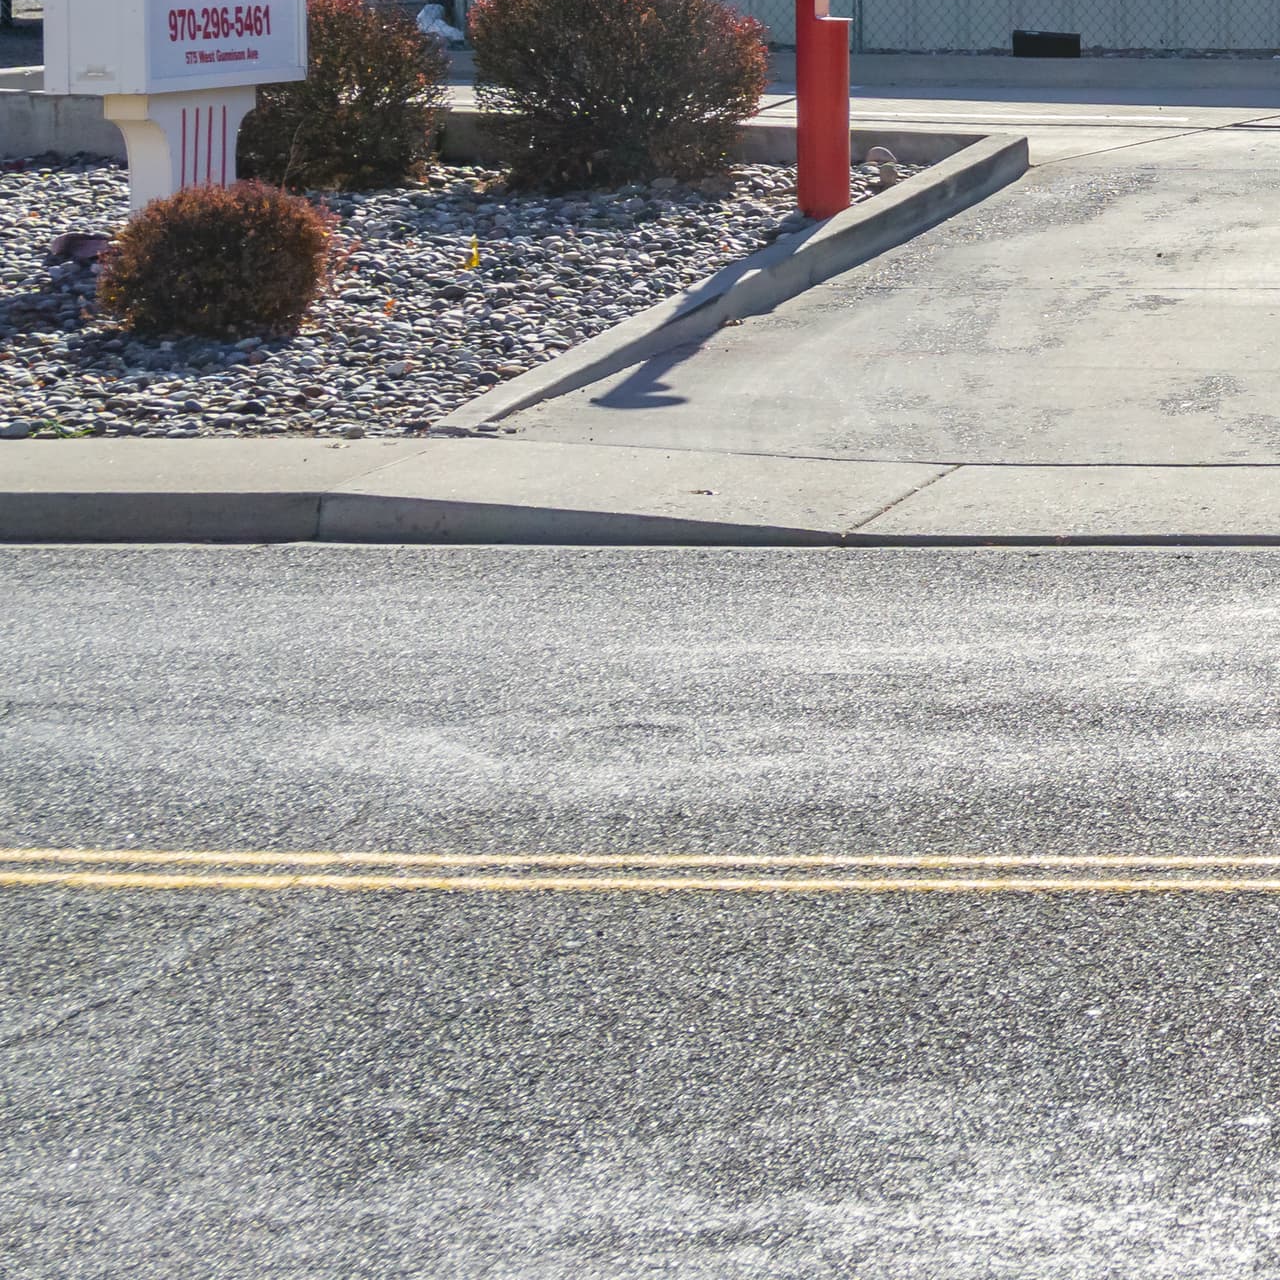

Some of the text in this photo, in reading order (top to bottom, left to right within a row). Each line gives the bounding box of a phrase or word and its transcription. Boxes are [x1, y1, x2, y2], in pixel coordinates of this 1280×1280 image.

[168, 4, 271, 43] 970-296-5461
[185, 50, 199, 65] 575
[199, 49, 216, 64] West
